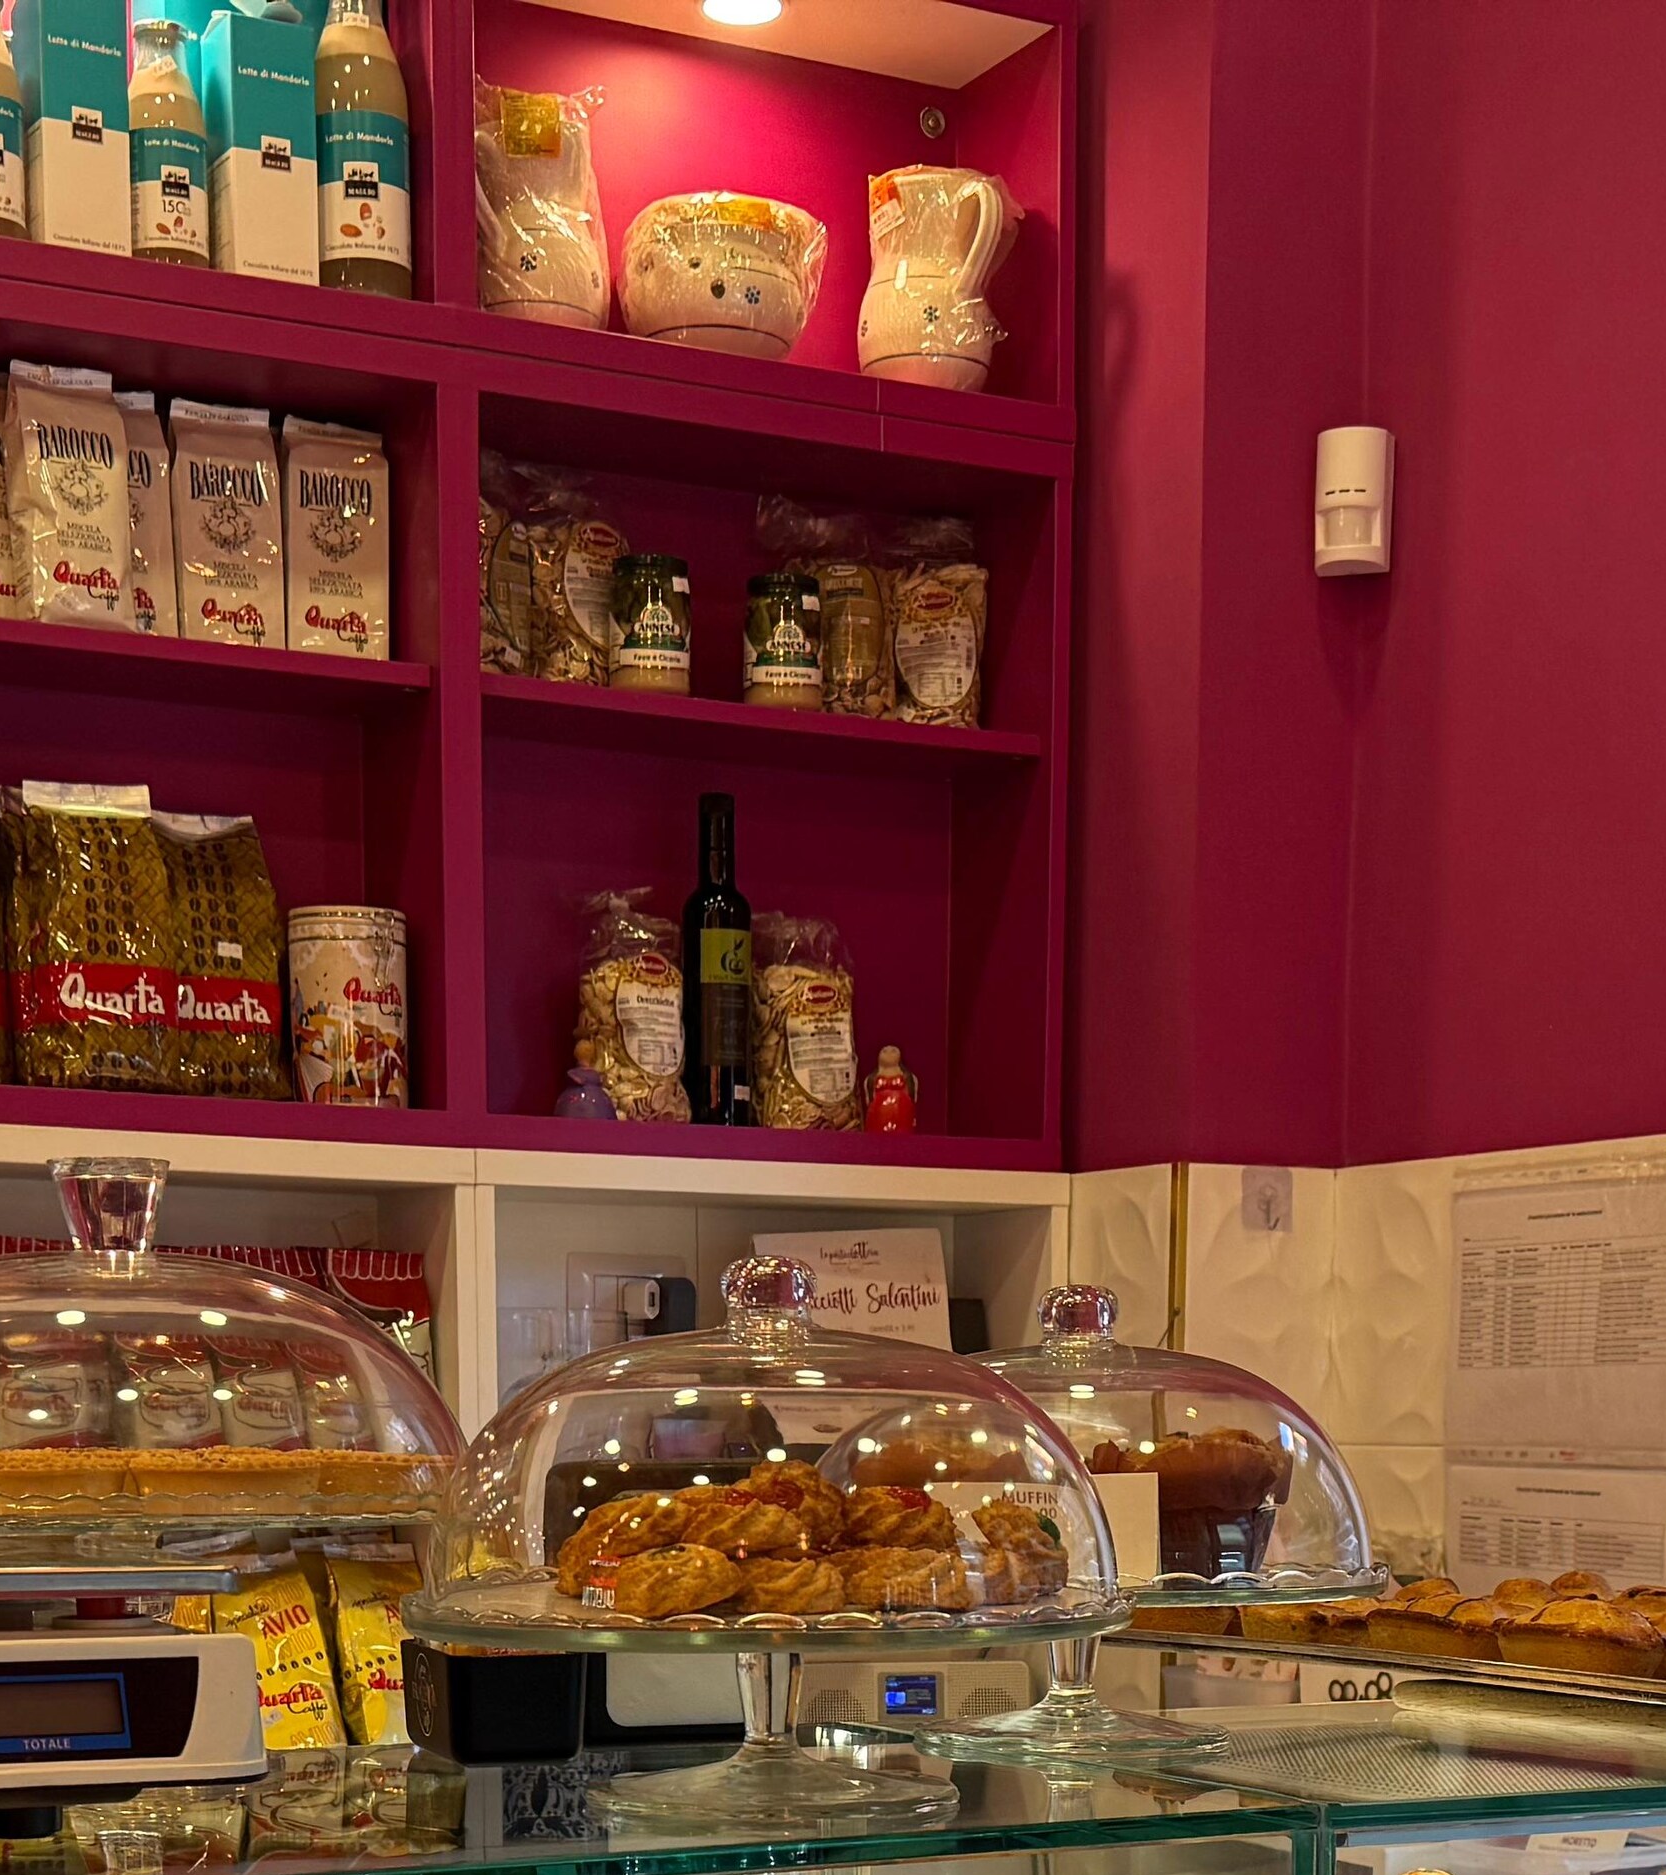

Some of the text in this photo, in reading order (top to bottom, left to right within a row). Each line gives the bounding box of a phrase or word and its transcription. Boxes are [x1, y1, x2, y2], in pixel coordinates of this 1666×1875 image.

[38, 423, 114, 469] BAROCCO
[190, 461, 263, 507] BAROCCO
[300, 470, 372, 516] BAROCCO
[59, 972, 166, 1017] Quarta
[178, 984, 271, 1025] Quarta
[343, 977, 402, 1007] Quarta
[809, 1281, 941, 1315] cciotti Salentini
[1002, 1491, 1058, 1506] MUFFIN
[261, 1604, 311, 1640] AVIO
[22, 1737, 71, 1751] TOTALE
